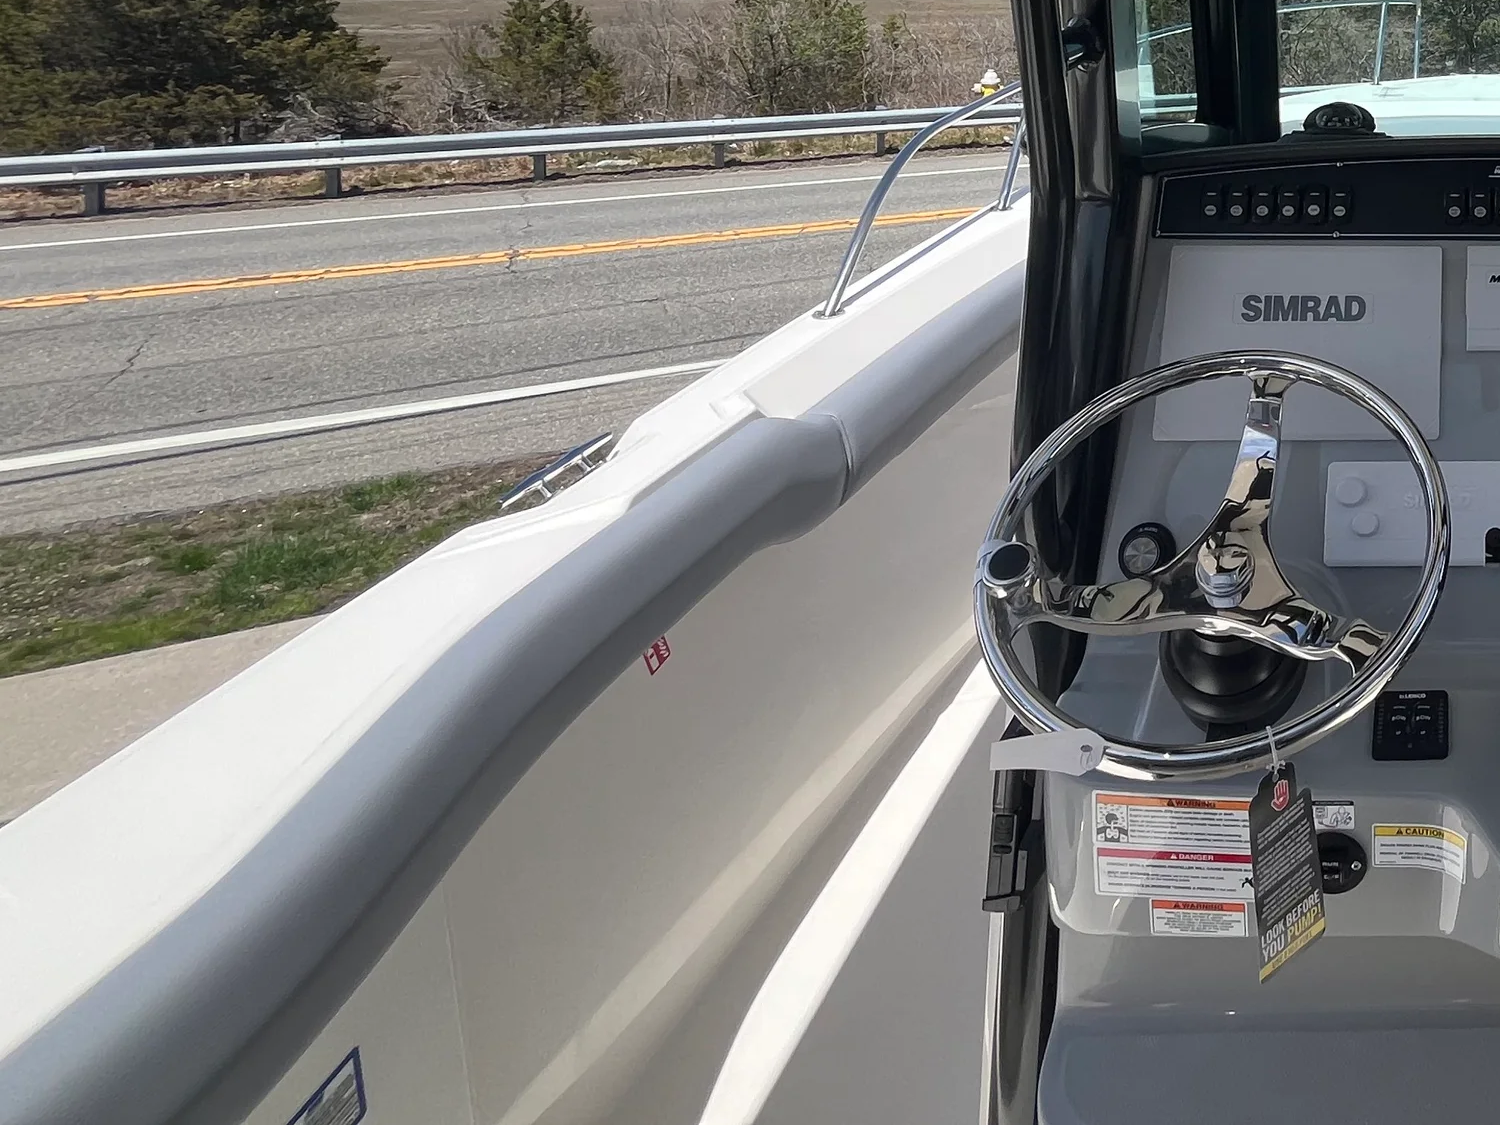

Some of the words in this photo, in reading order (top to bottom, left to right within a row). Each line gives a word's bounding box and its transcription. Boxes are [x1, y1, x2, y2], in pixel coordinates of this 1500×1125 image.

[1241, 294, 1366, 322] SIMRAD
[1174, 799, 1216, 808] WARNING
[1405, 827, 1445, 838] CAUTION
[1178, 853, 1214, 861] DANGER
[1261, 918, 1286, 949] LOOK
[1285, 888, 1321, 928] BEFORE
[1262, 933, 1285, 963] YOU
[1287, 902, 1322, 943] PUMP!
